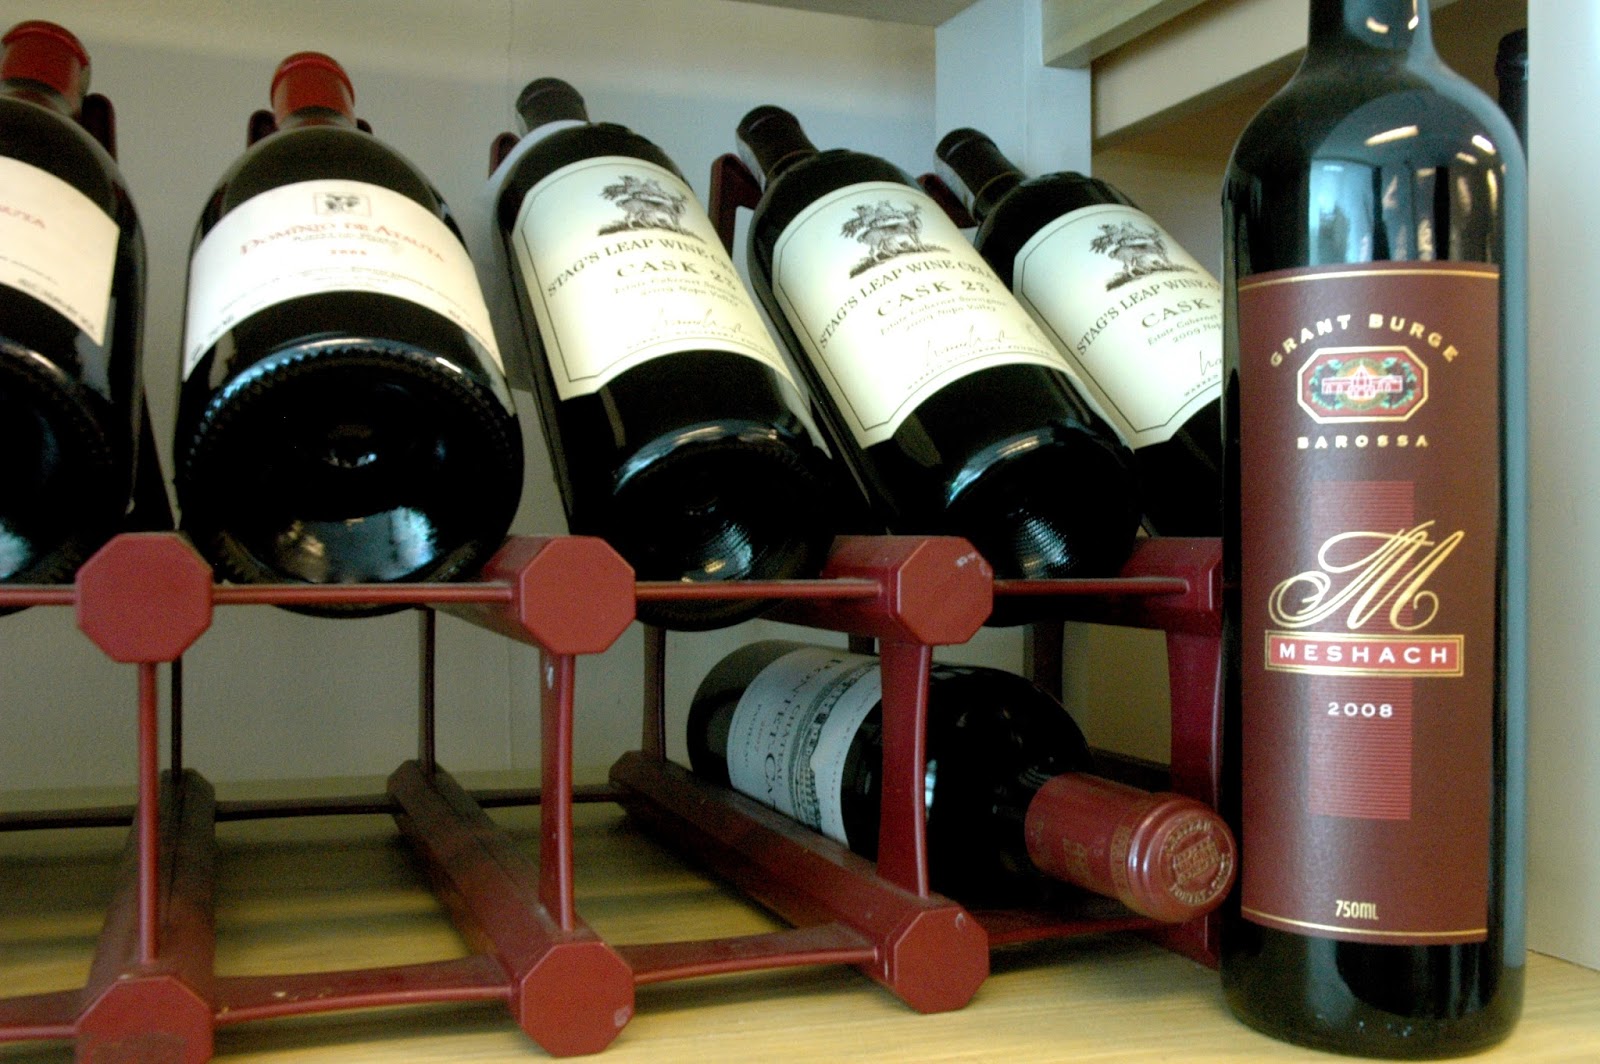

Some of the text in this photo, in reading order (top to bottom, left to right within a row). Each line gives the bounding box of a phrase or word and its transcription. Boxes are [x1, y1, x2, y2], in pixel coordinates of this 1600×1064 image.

[547, 238, 709, 298] STAG'S LEAP WINE
[616, 259, 700, 279] CASK
[819, 295, 859, 349] STAG'S
[860, 268, 902, 298] LEAP
[906, 259, 955, 273] WINE
[876, 280, 952, 318] CASK
[1141, 298, 1211, 329] CASK
[1076, 278, 1209, 356] STAG'S LEAP WINE
[1147, 313, 1218, 346] Estate Cabernet
[1270, 314, 1351, 367] GRANT
[1368, 313, 1459, 362] BURGE
[1297, 434, 1429, 449] BAROSSA
[1279, 642, 1447, 665] MESHACH
[1327, 701, 1394, 719] 2008
